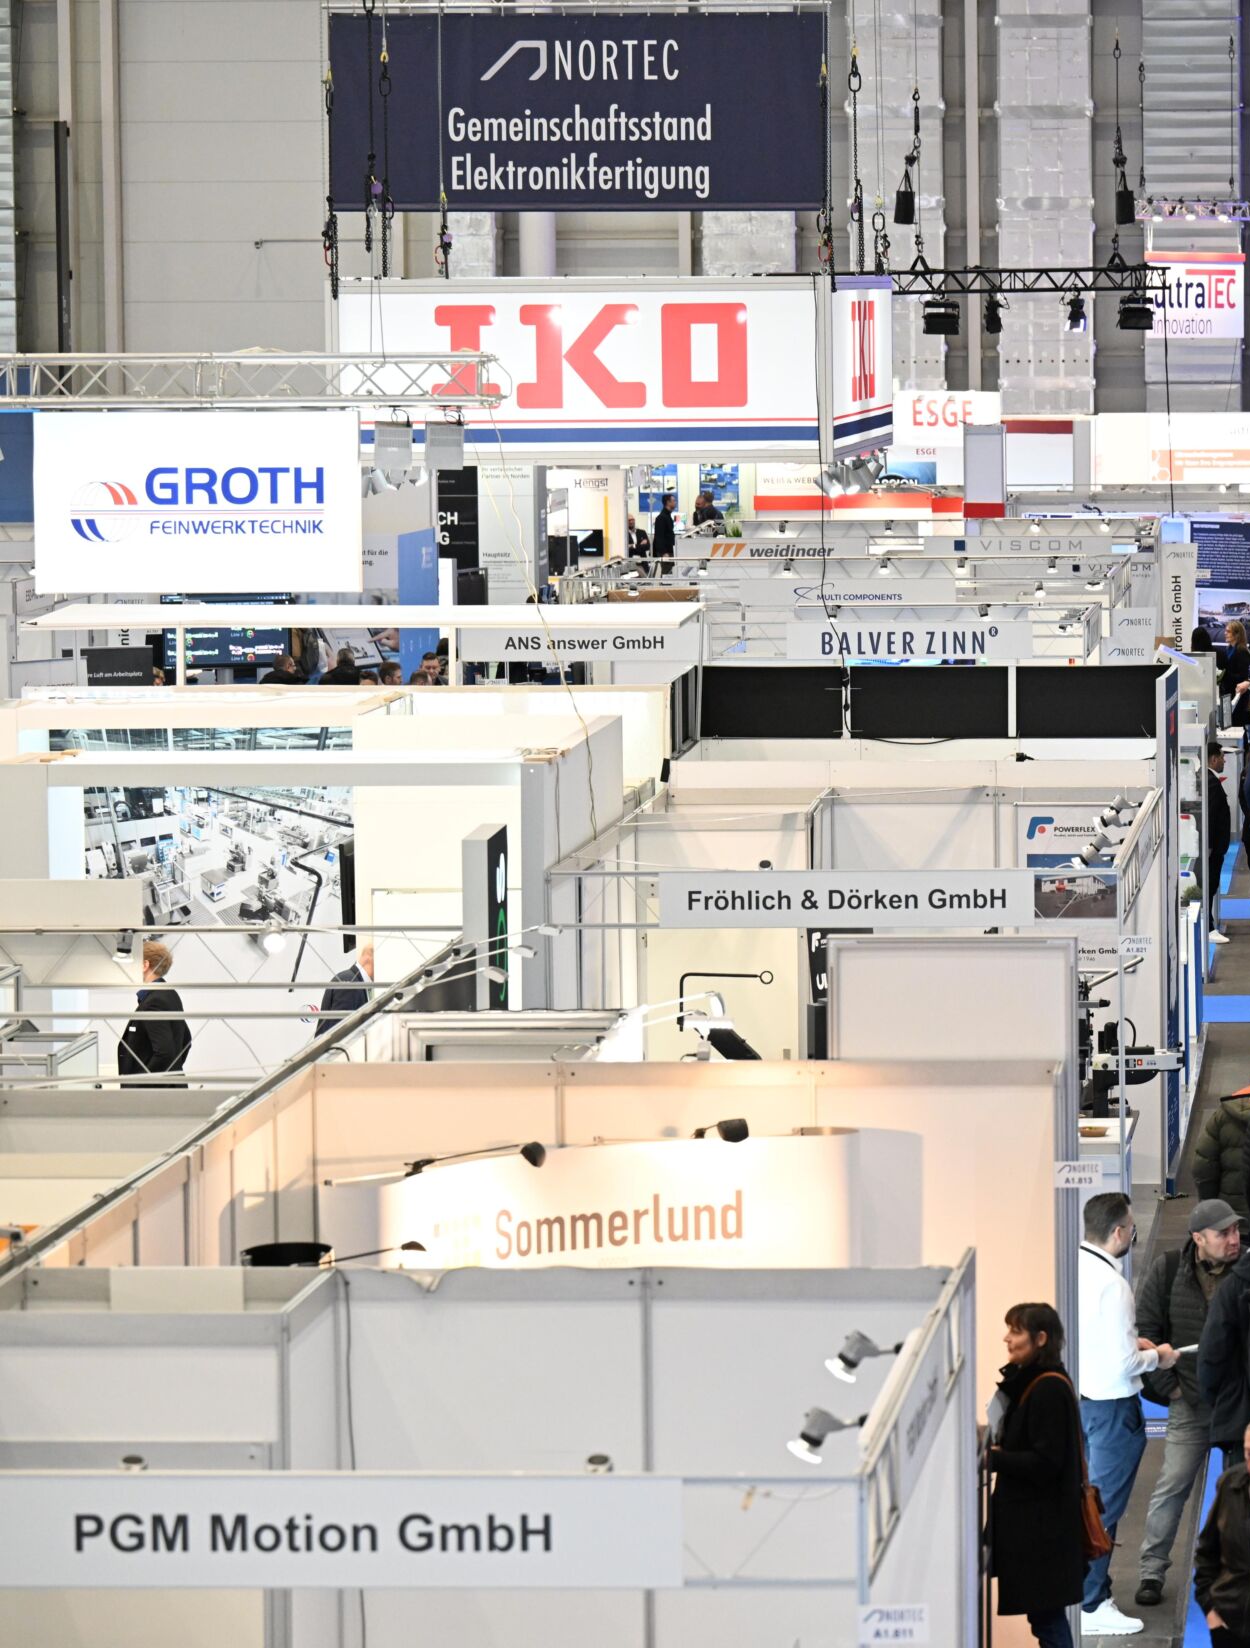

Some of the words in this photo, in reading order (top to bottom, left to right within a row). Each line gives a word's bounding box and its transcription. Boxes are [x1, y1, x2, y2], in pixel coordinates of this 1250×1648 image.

[553, 39, 680, 81] NORTEC
[447, 104, 712, 143] Gemeinschaftsstand
[451, 153, 711, 199] Elektronikfertigung
[1153, 317, 1213, 335] innovation
[432, 302, 748, 410] IKO
[912, 400, 974, 427] ESGE
[144, 467, 325, 506] GROTH
[149, 520, 325, 535] FEINWERKTECHNIK
[980, 540, 1083, 551] VISCOM
[1088, 564, 1151, 572] VISOM
[817, 593, 842, 601] MULTI
[843, 593, 903, 601] COMPONENTS
[1171, 575, 1182, 613] GmbH
[504, 636, 542, 651] ANS
[546, 639, 608, 651] answer
[611, 636, 665, 651] GmbH
[821, 629, 916, 656] BALVER
[1120, 648, 1145, 656] NORTEC
[687, 887, 793, 912] Fröhlich
[800, 889, 819, 912] &
[827, 887, 919, 911] Dörken
[927, 887, 1008, 910] GmbH
[1131, 937, 1153, 945] NORTEC
[1072, 1163, 1099, 1173] NORTEC
[1064, 1177, 1093, 1185] A1.813
[495, 1189, 743, 1260] Sommerlund
[72, 1513, 191, 1553] PGM
[208, 1512, 380, 1553] Motion
[398, 1512, 554, 1553] GmbH
[884, 1609, 925, 1622] NORTEC
